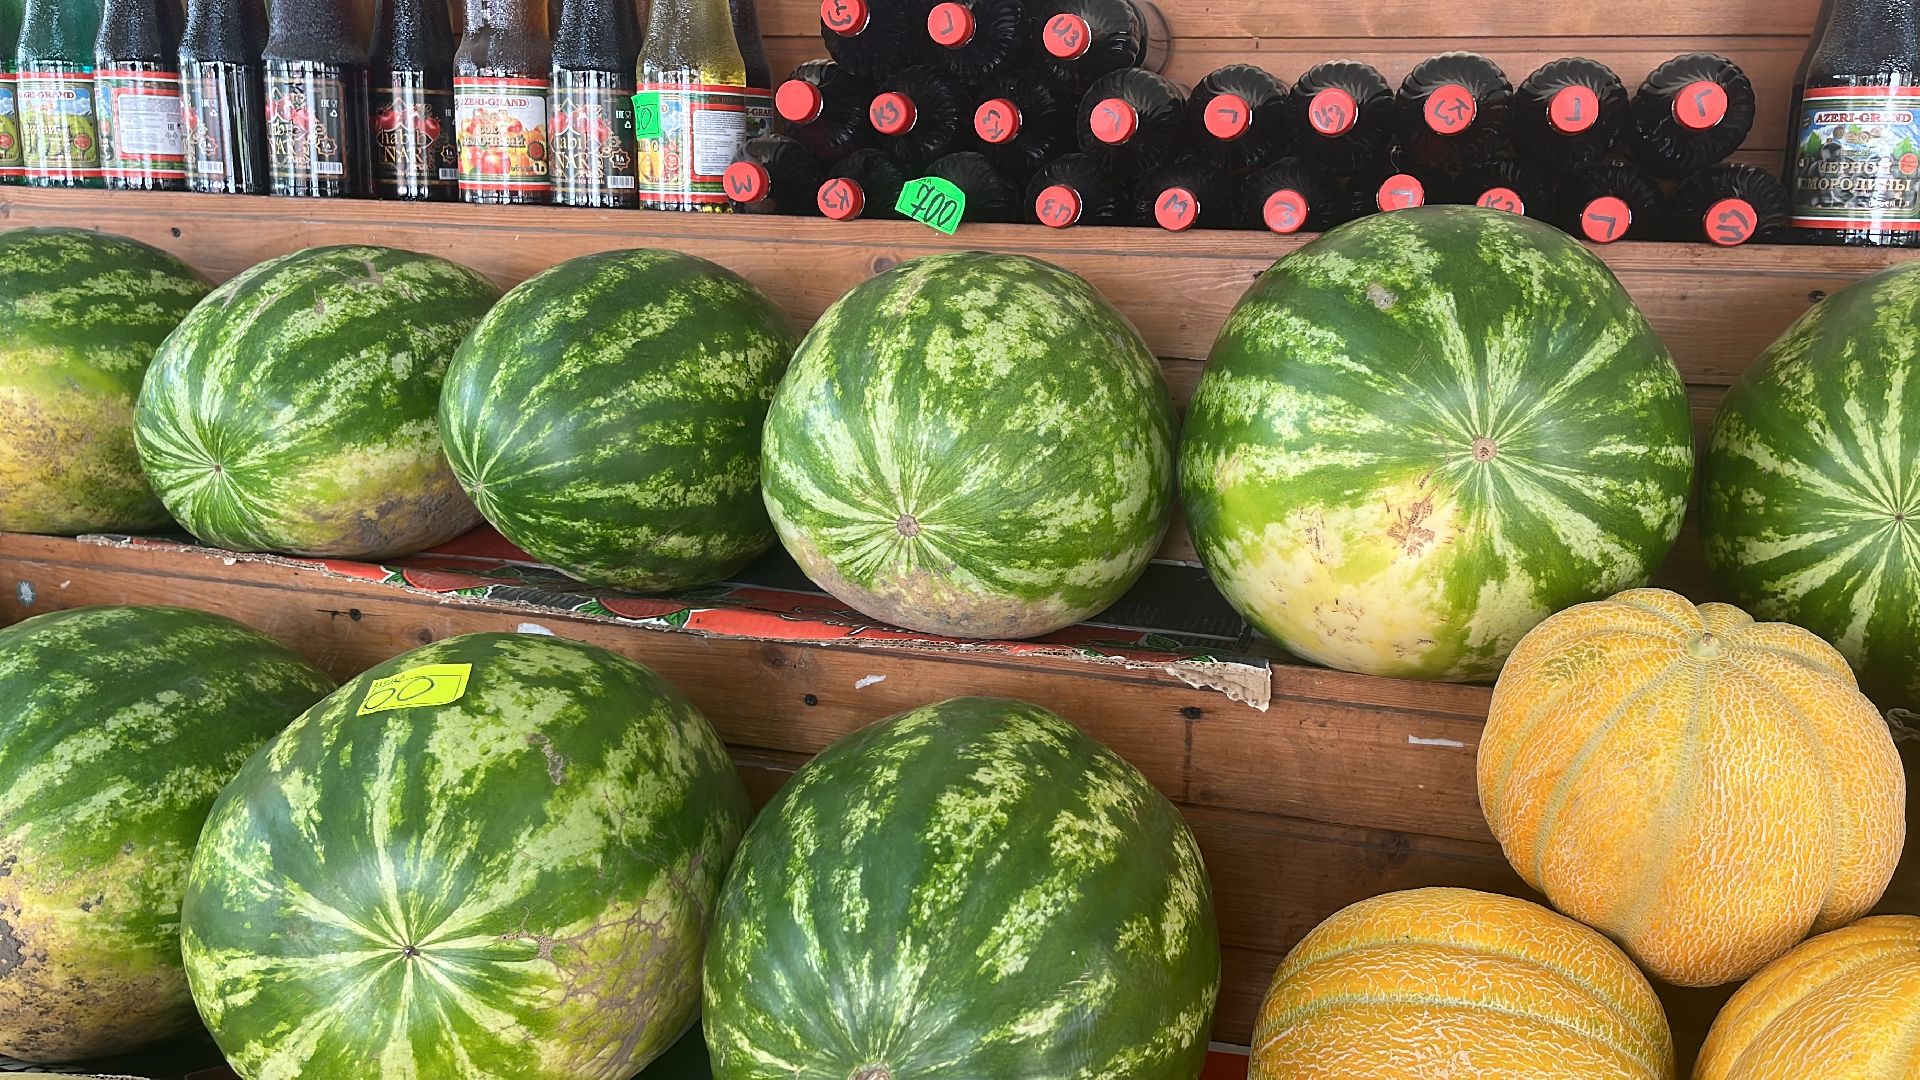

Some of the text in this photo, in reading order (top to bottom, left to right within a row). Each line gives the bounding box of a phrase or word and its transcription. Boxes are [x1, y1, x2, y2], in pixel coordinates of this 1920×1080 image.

[1814, 112, 1912, 124] AZERI-GRND
[266, 119, 301, 136] abib
[381, 128, 427, 145] habib
